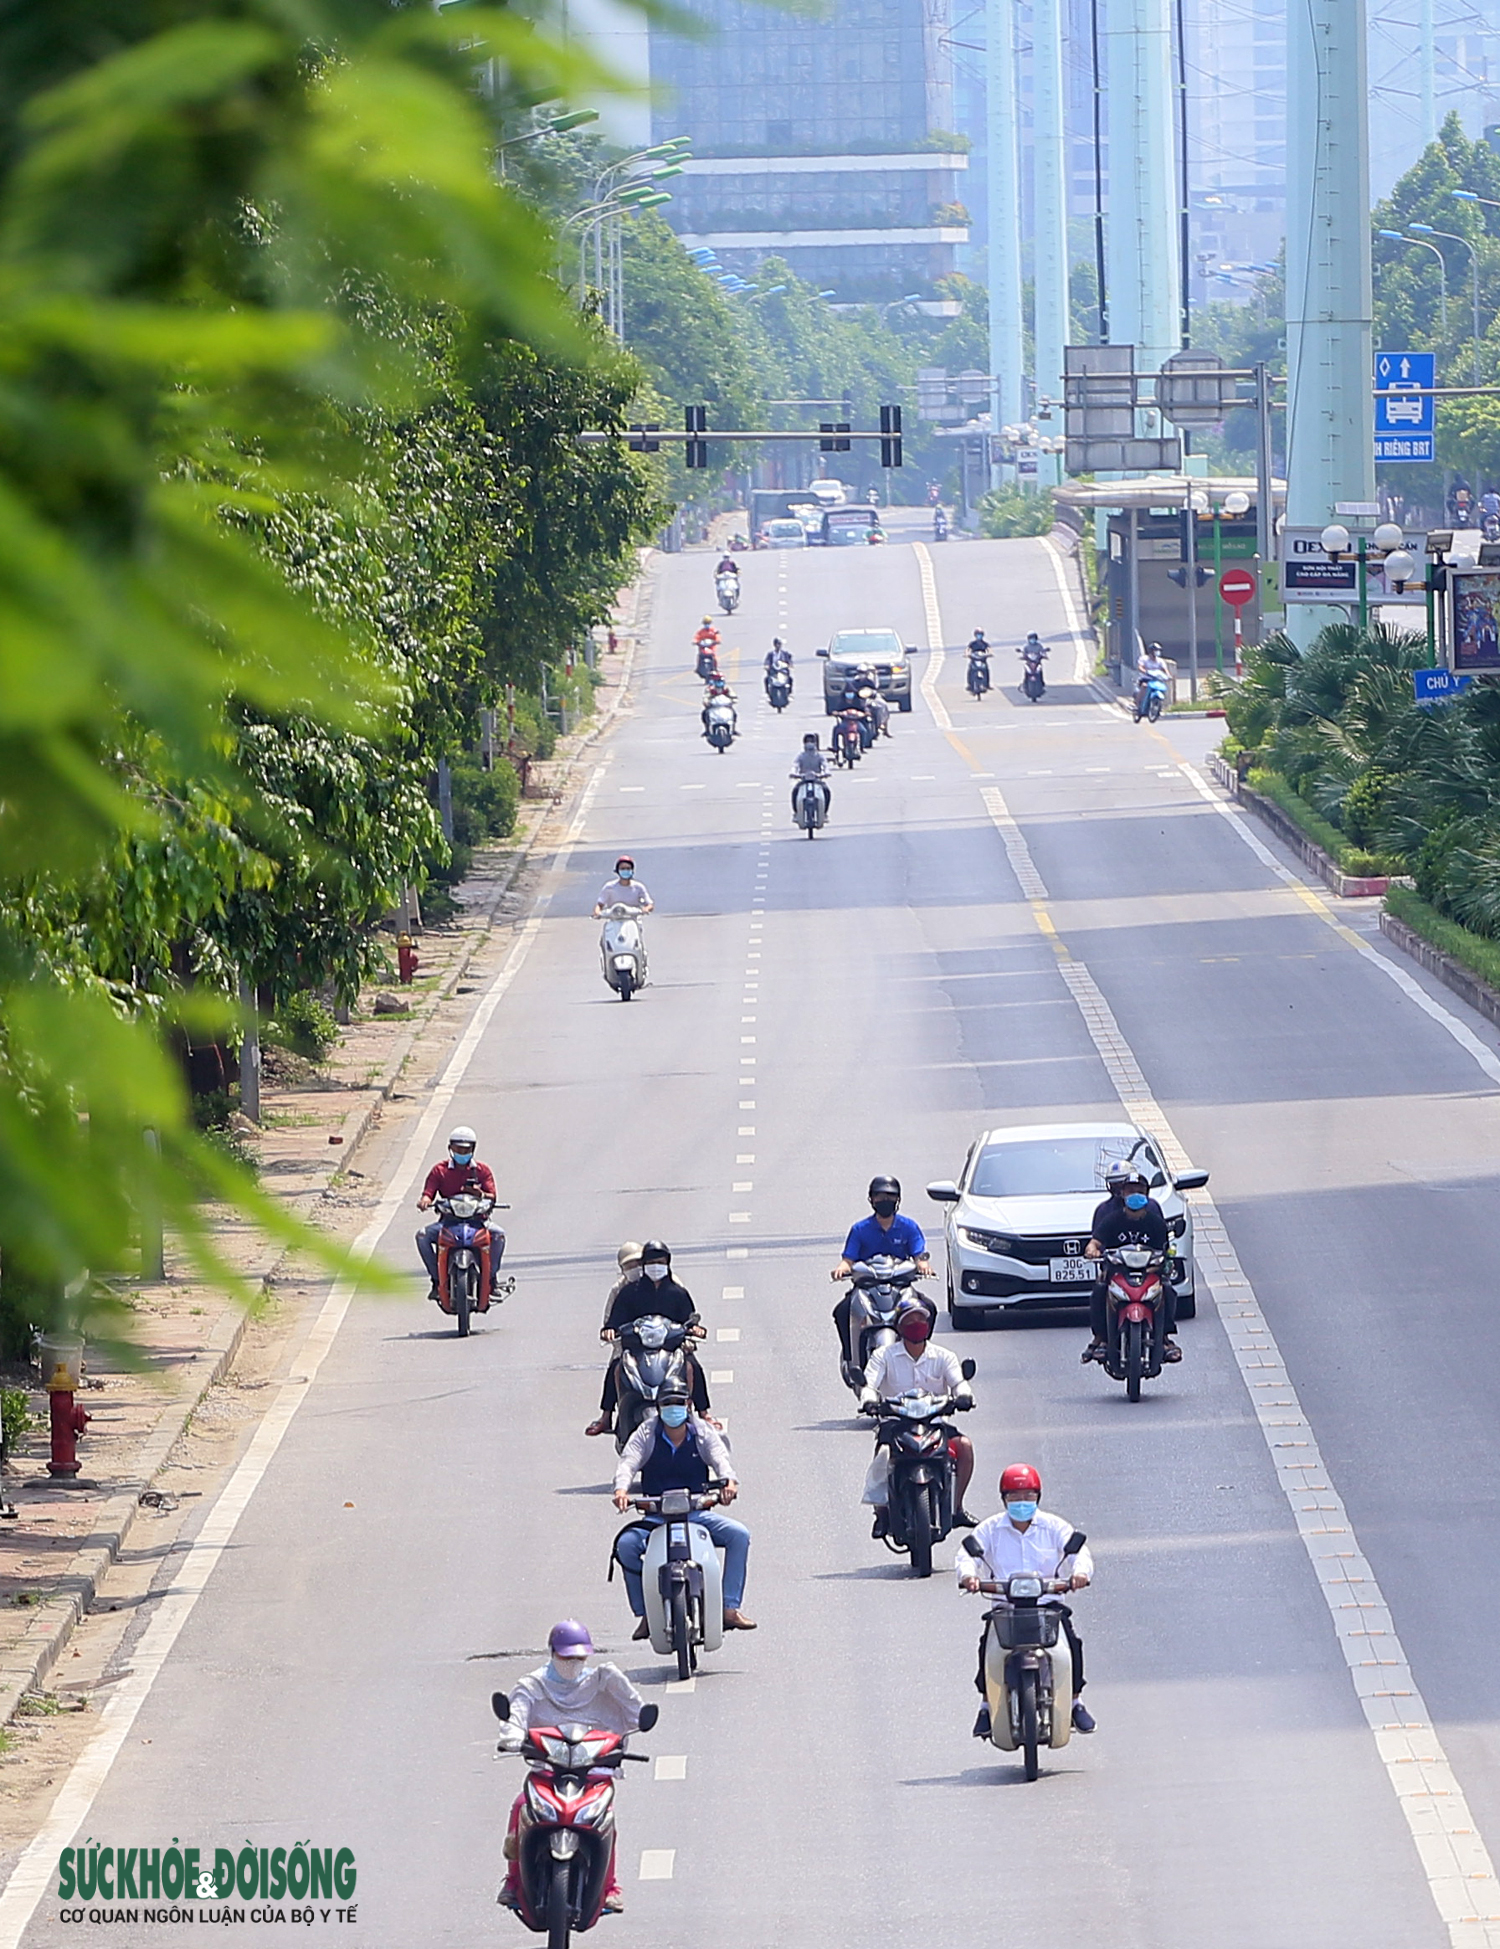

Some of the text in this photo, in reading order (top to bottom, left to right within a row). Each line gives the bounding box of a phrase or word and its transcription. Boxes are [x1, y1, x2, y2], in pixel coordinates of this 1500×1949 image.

[1413, 441, 1430, 456] BRT
[1426, 672, 1448, 690] CHÚ
[1055, 1269, 1091, 1280] 825.51
